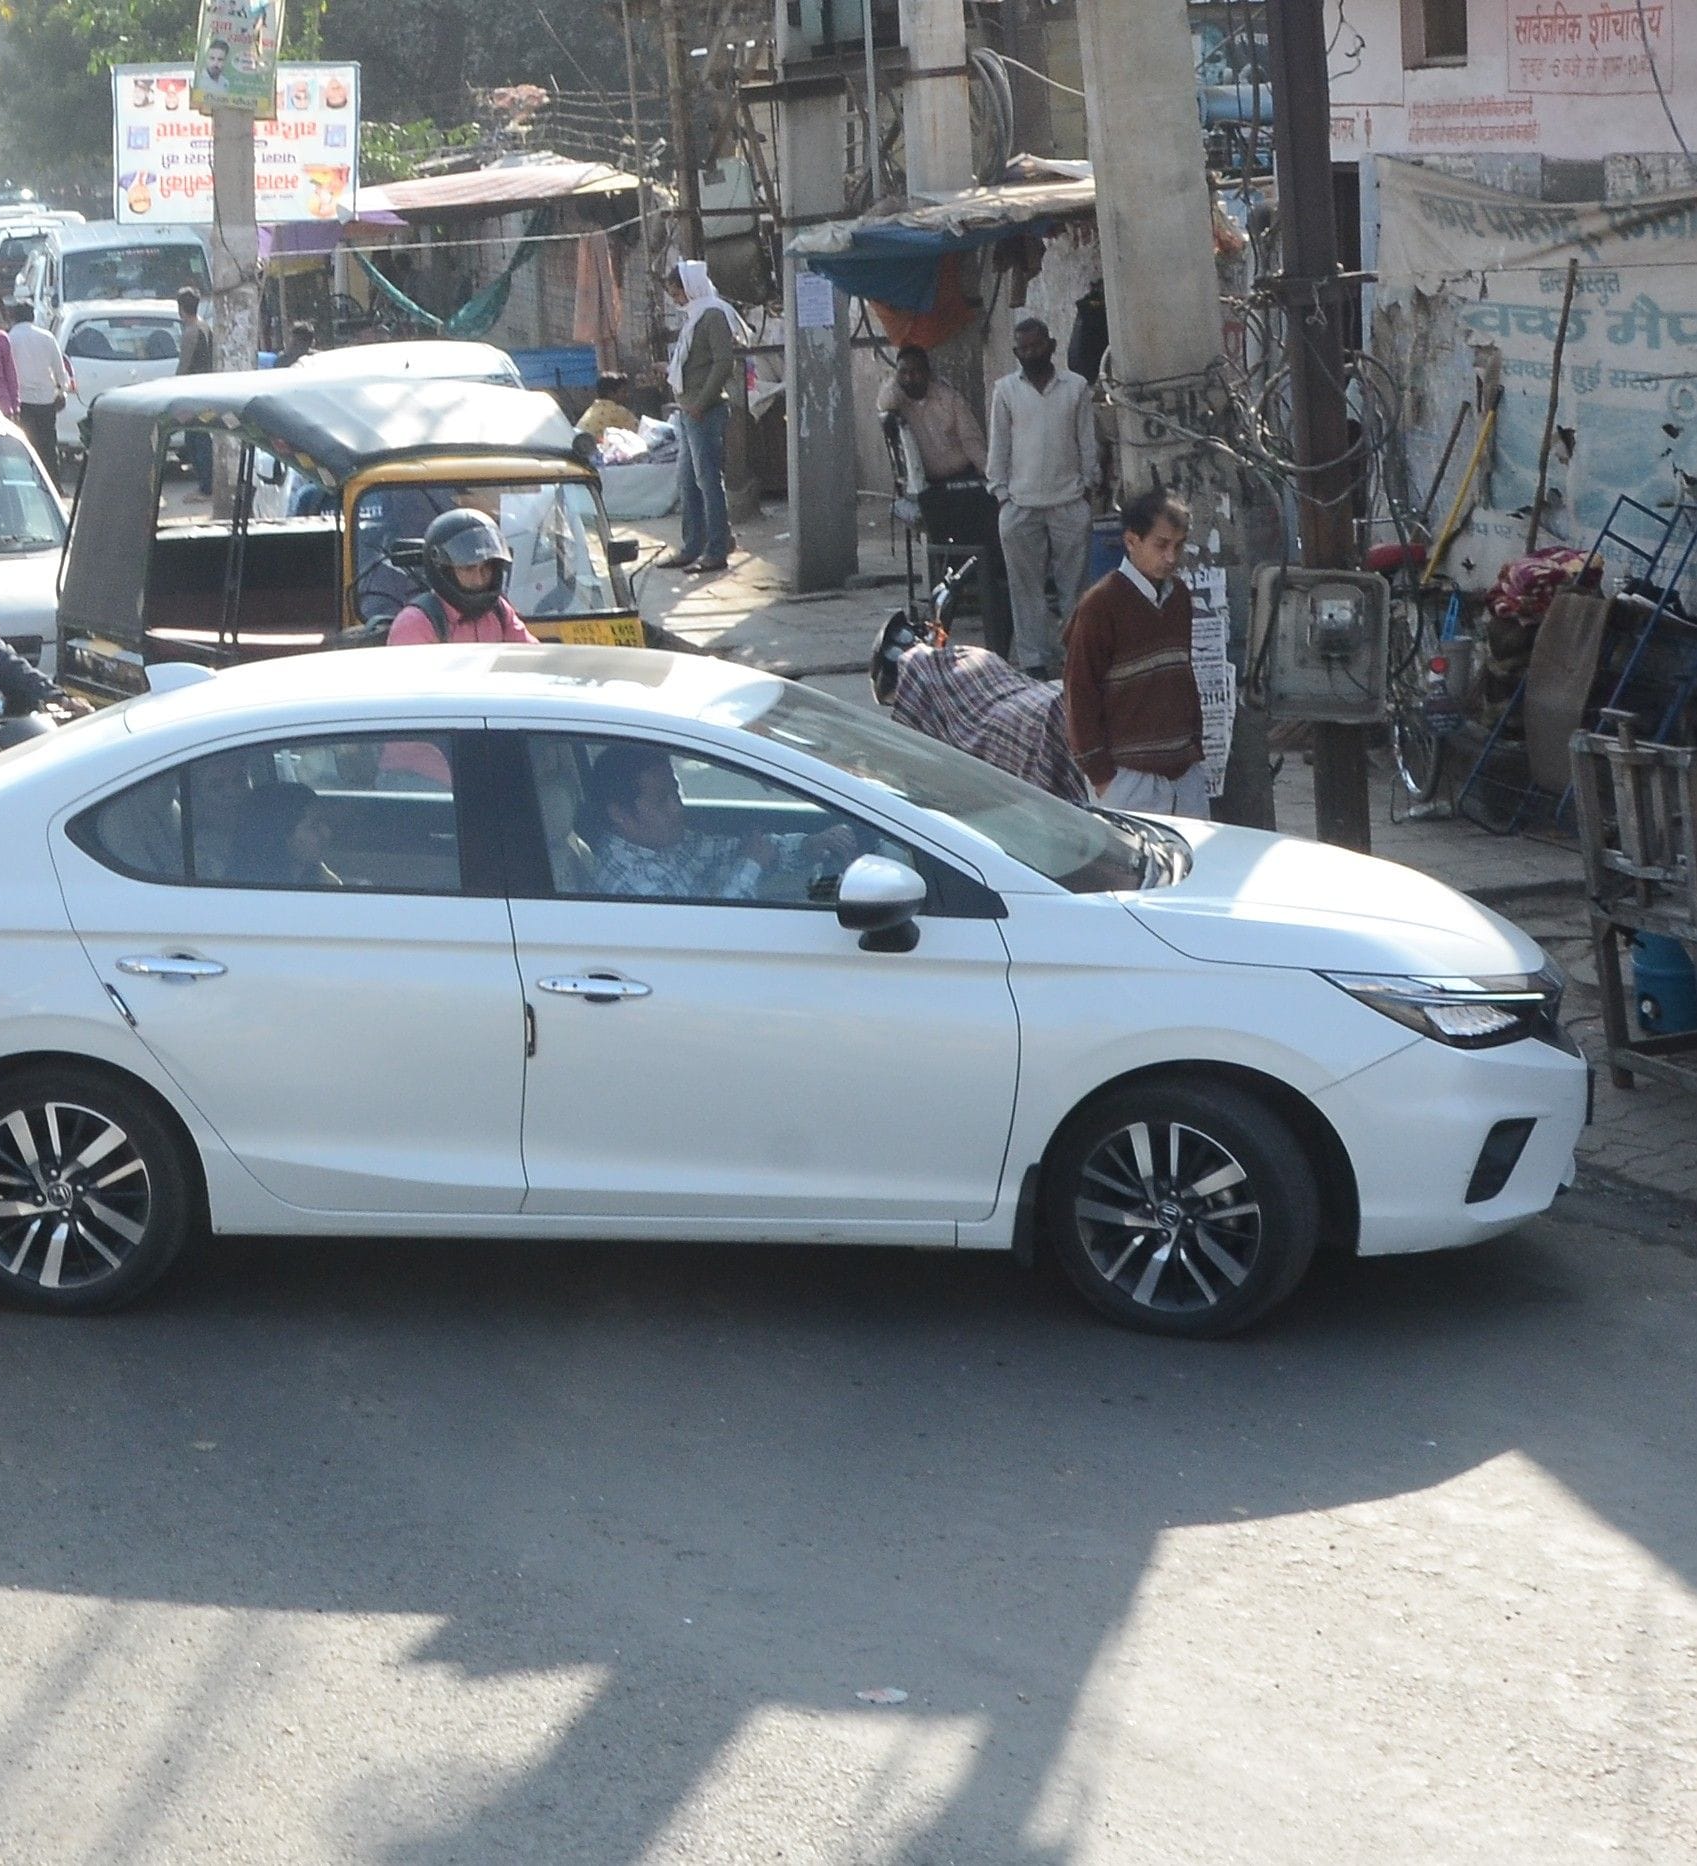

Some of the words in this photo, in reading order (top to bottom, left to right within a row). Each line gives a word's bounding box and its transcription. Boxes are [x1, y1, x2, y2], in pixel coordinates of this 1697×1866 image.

[1515, 1, 1582, 45] सार्वजनिक
[1587, 3, 1664, 51] शौचालय
[159, 174, 212, 198] ल्मीकी
[255, 174, 299, 191] भगव
